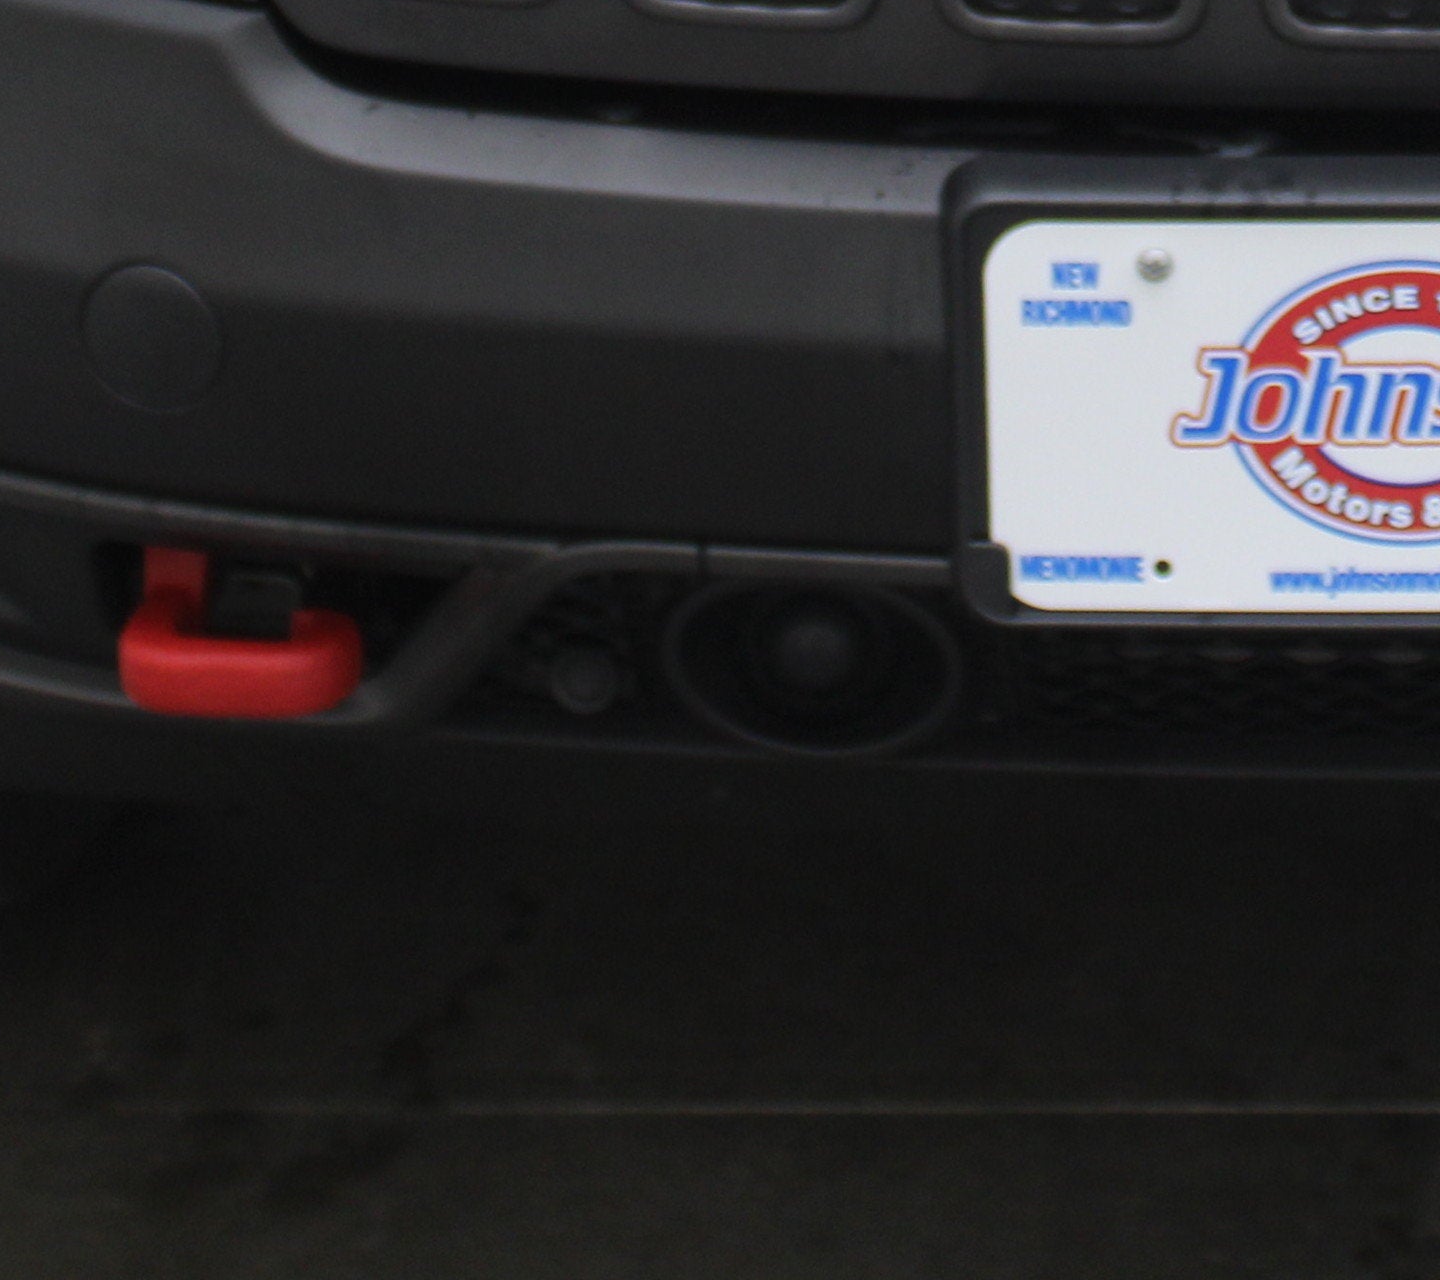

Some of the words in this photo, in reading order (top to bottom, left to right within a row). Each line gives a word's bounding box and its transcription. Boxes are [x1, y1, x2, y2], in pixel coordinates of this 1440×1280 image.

[1051, 262, 1099, 290] NEW
[1022, 299, 1132, 327] RICHMOND
[1293, 285, 1420, 344] SINCE
[1271, 446, 1415, 529] Motors
[1020, 556, 1145, 583] MENOMONIE
